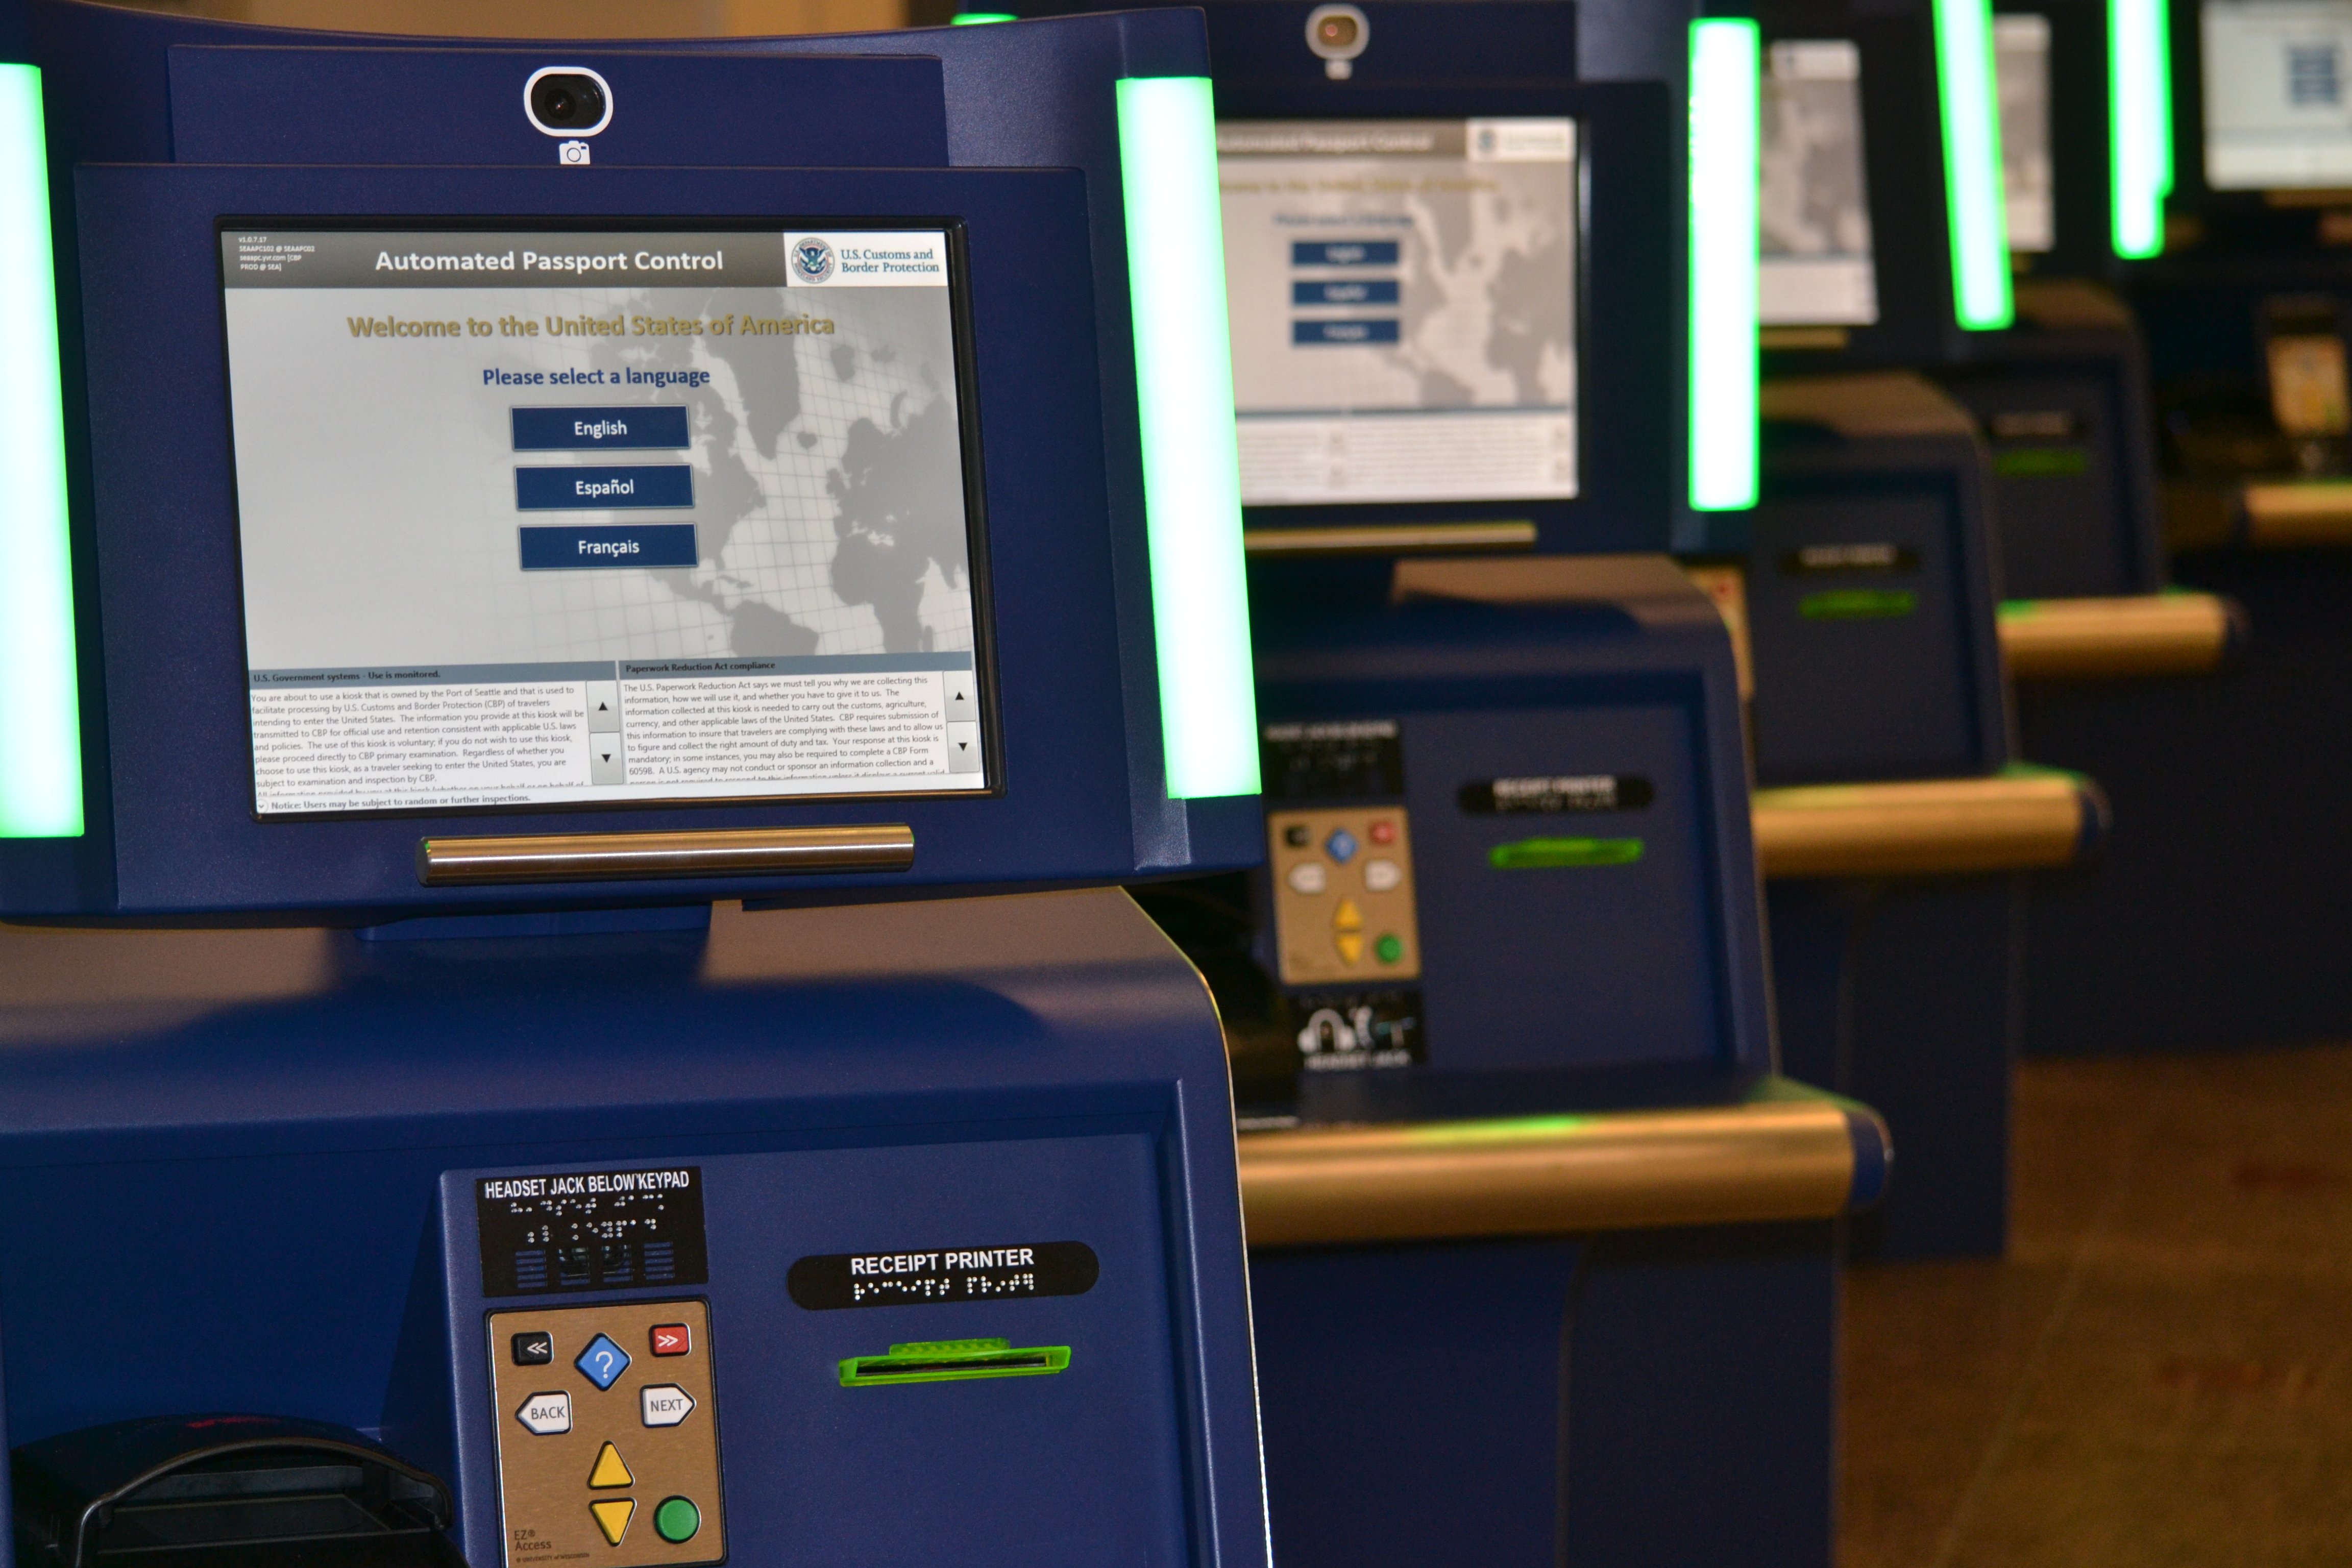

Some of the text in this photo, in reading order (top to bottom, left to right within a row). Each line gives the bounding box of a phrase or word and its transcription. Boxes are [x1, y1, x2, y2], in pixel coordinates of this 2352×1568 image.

[375, 251, 723, 274] Automated Passport Control
[841, 249, 934, 260] U.S. Customs and
[842, 261, 940, 273] Border Protection
[347, 313, 834, 338] Welcome to the United States of America
[483, 367, 710, 387] Please select a language
[574, 421, 627, 439] English
[576, 479, 634, 498] Español
[578, 540, 640, 557] Français
[272, 673, 325, 681] Government
[326, 673, 360, 682] systems
[394, 670, 440, 678] monitored.
[626, 664, 669, 674] Paperwork
[671, 663, 712, 671] Reduction
[730, 661, 775, 671] compliance
[251, 706, 285, 714] facilitate
[288, 704, 330, 715] processing
[332, 704, 341, 714] by
[361, 703, 395, 711] Customs
[414, 701, 440, 709] Border
[443, 700, 482, 708] Protection
[484, 700, 505, 709] (CBP)
[517, 698, 550, 706] travelers
[625, 707, 669, 716] information
[671, 706, 705, 714] collected
[732, 704, 751, 713] kiosk
[762, 703, 789, 712] needed
[802, 704, 820, 713] carry
[851, 702, 883, 710] customs,
[886, 699, 926, 710] agriculture,
[626, 721, 659, 729] currency,
[701, 717, 739, 727] applicable
[783, 715, 808, 723] United
[856, 712, 886, 722] requires
[888, 711, 929, 720] submission
[252, 730, 298, 739] transmitted
[404, 726, 439, 734] retention
[442, 724, 481, 733] consistent
[502, 723, 541, 733] applicable
[628, 754, 671, 765] mandatory;
[705, 752, 741, 762] instances,
[806, 749, 837, 760] required
[849, 748, 884, 758] complete
[629, 767, 654, 775] 6059B.
[683, 767, 710, 775] agency
[745, 763, 775, 771] conduct
[787, 764, 817, 772] sponsor
[830, 760, 873, 768] information
[875, 758, 911, 767] collection
[255, 779, 284, 789] subject
[298, 777, 346, 786] examination
[365, 775, 405, 786] inspection
[407, 775, 417, 784] by
[419, 774, 436, 782] CBP.
[271, 801, 301, 810] Notice:
[304, 800, 326, 808] Users
[329, 801, 346, 810] may
[361, 798, 391, 808] subject
[405, 797, 437, 805] random
[482, 793, 530, 804] inspections.
[485, 1171, 690, 1198] HEADSET JACK BELOW KEYPAD
[851, 1248, 1035, 1276] RECEIPT PRINTER
[595, 1351, 614, 1379] ?
[531, 1406, 566, 1420] BACK
[650, 1398, 683, 1412] NEXT
[515, 1541, 552, 1551] Access
